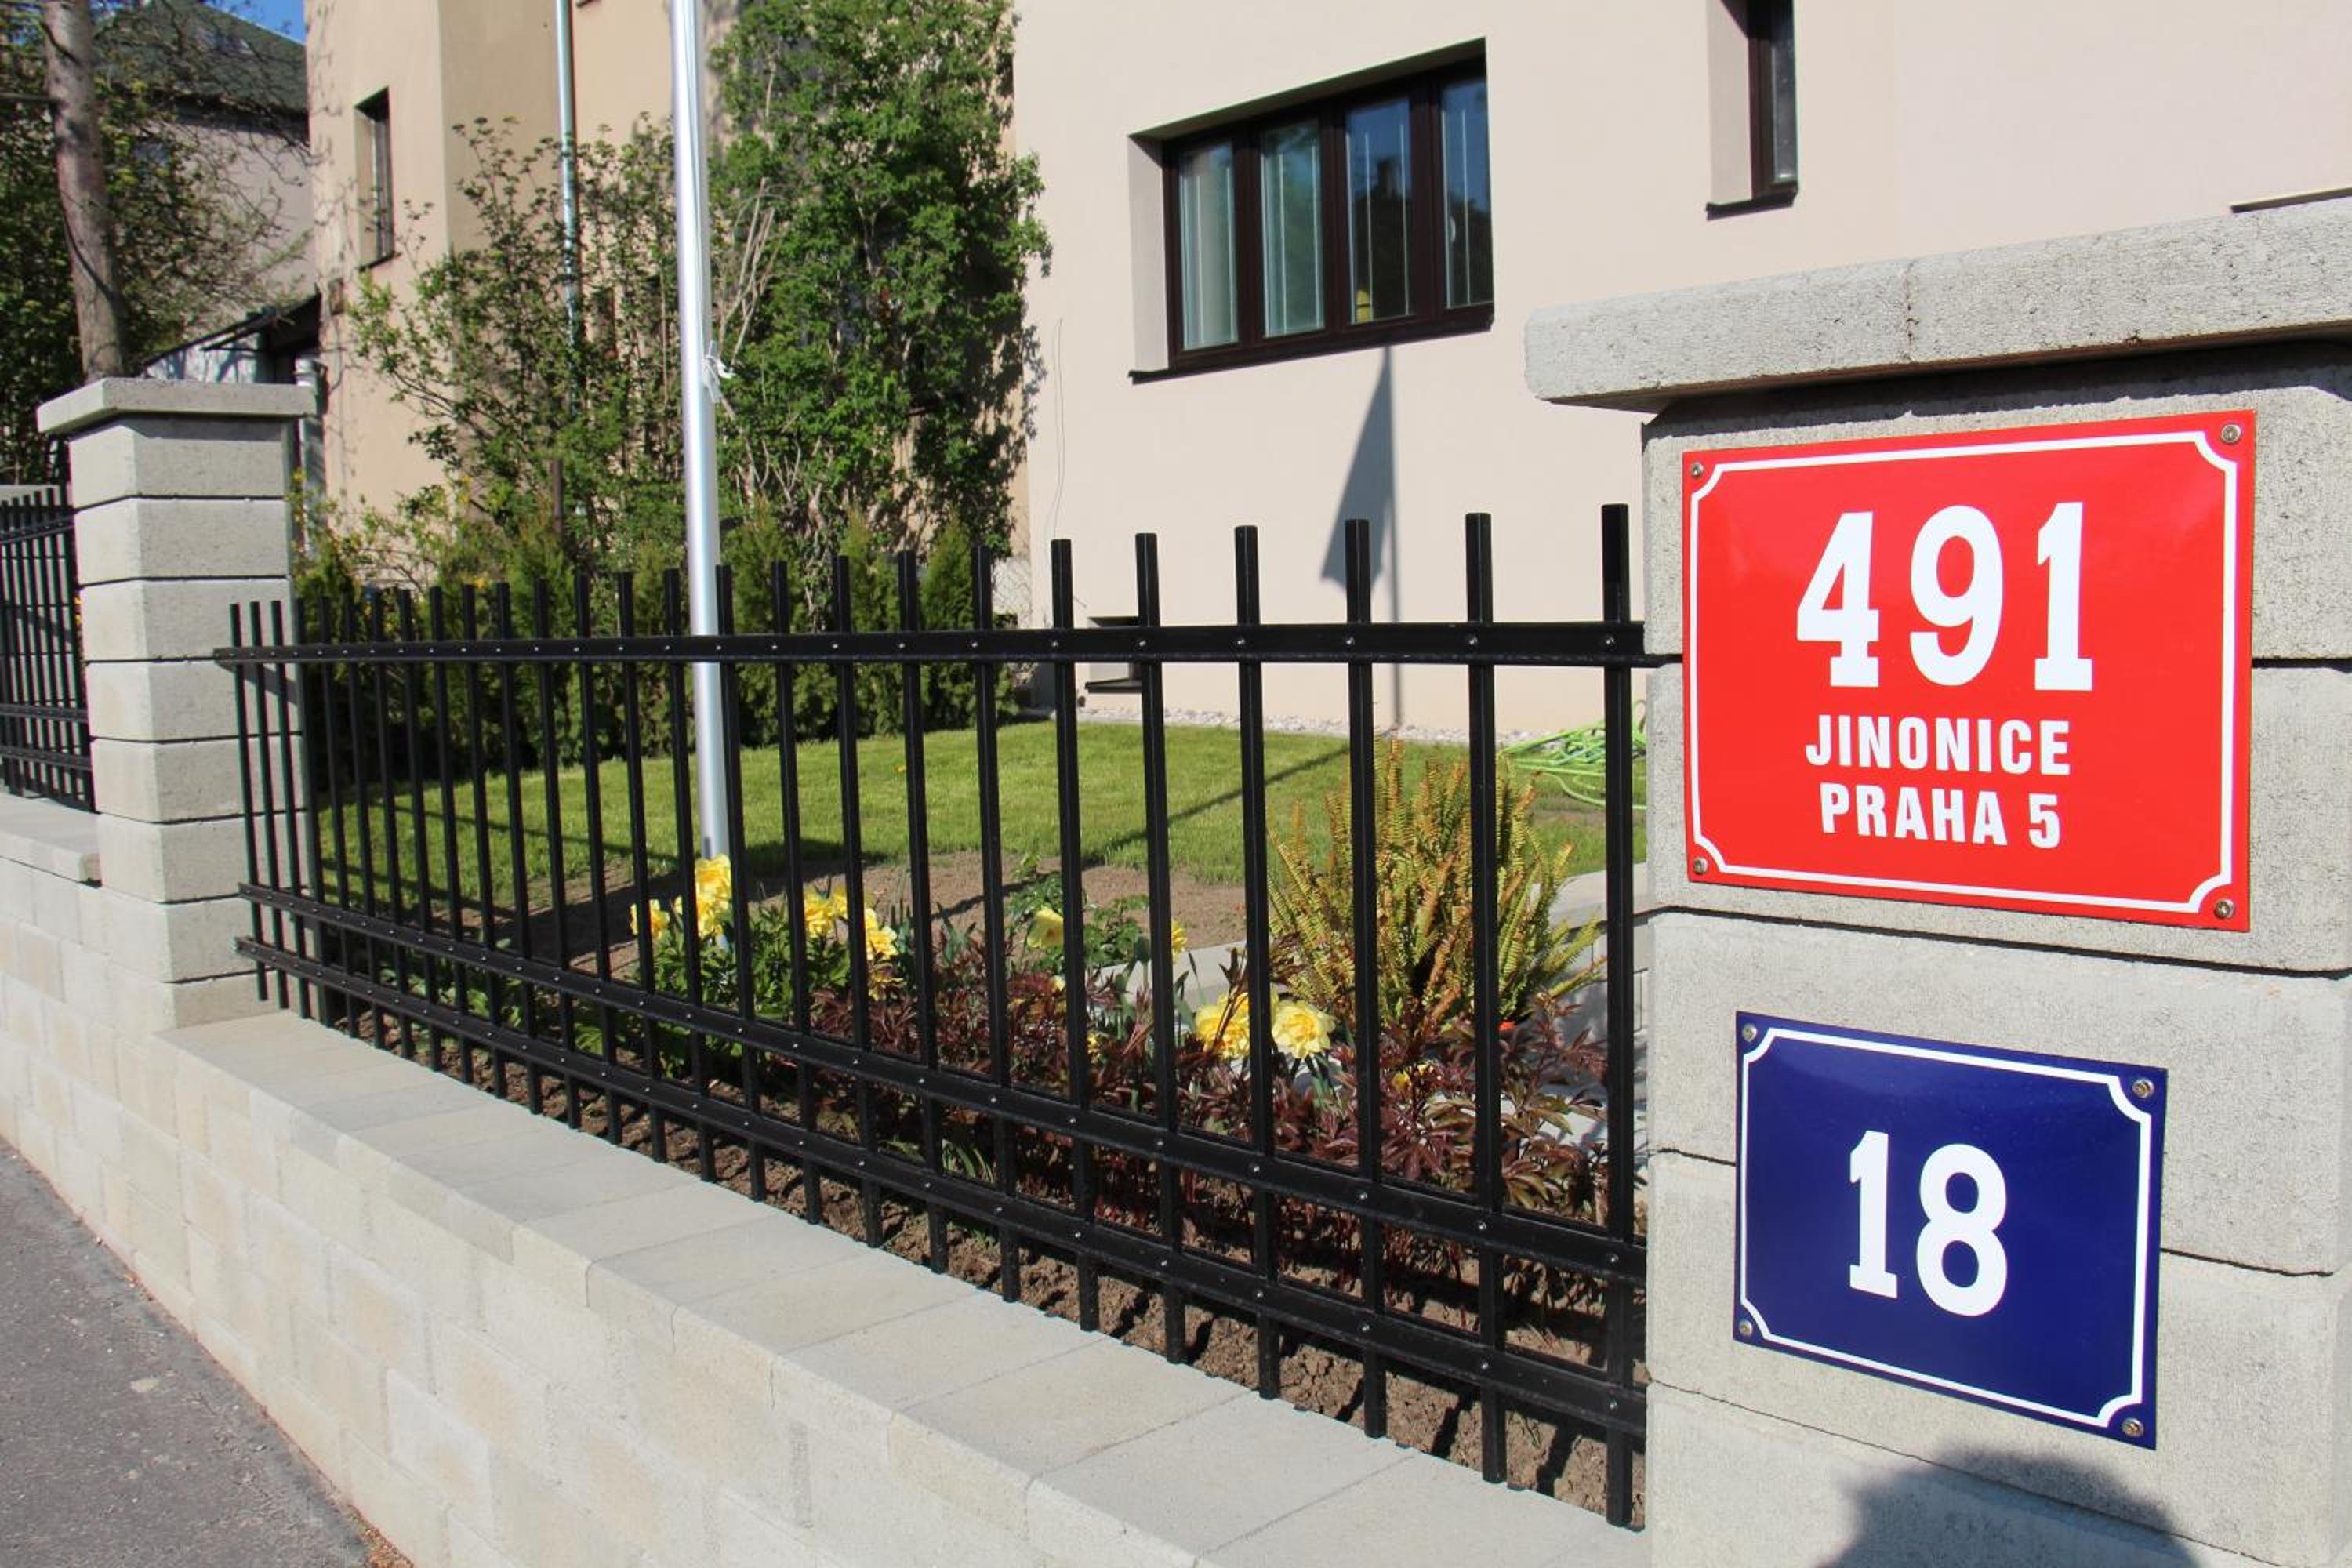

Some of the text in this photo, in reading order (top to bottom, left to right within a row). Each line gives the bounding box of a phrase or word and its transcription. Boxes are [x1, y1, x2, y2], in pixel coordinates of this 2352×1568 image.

[1796, 501, 2093, 691] 491
[1806, 714, 2071, 775] JINONICE
[1820, 782, 2061, 849] PRAHA 5
[1849, 1130, 2008, 1317] 18
